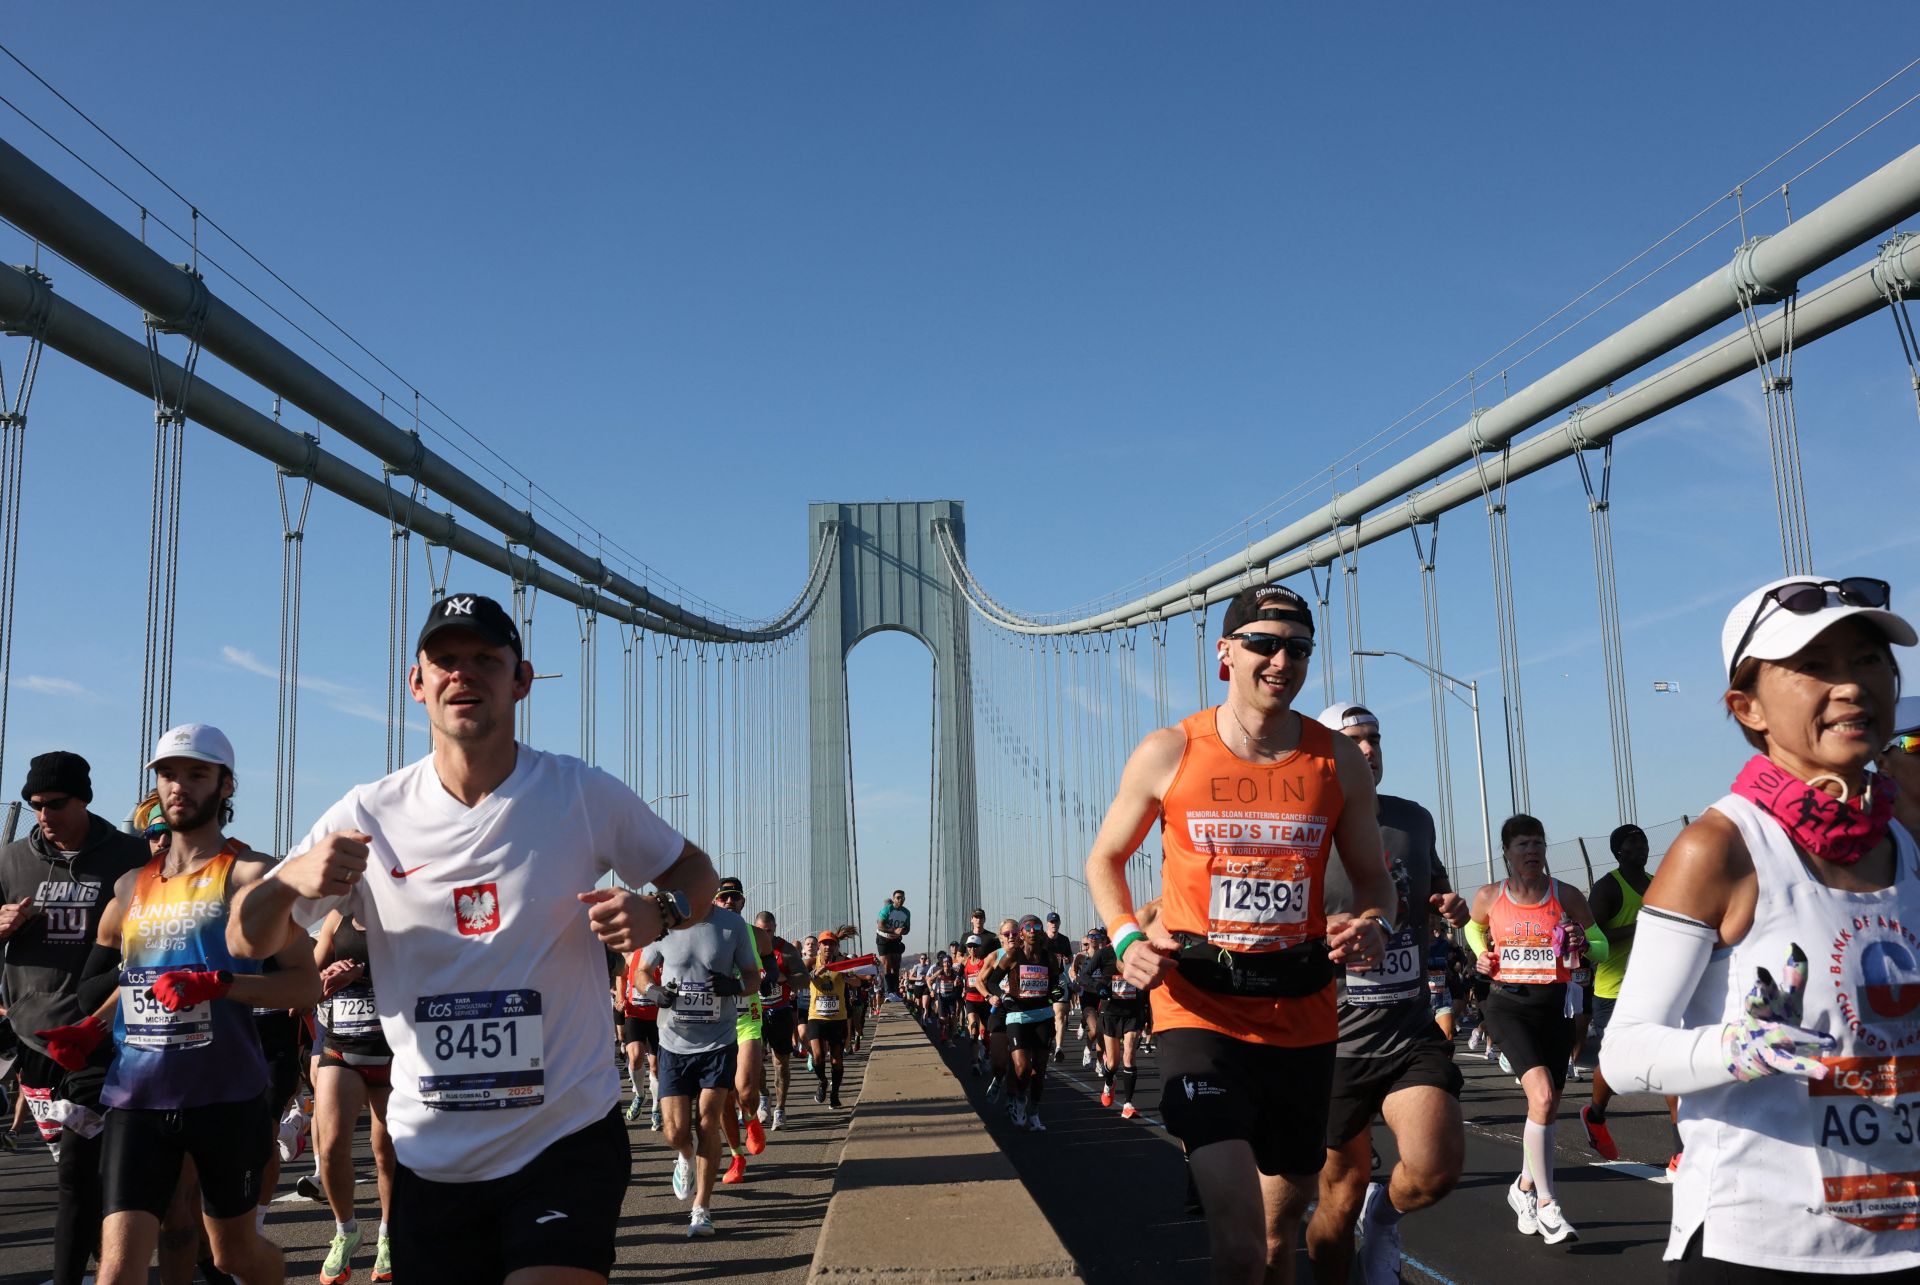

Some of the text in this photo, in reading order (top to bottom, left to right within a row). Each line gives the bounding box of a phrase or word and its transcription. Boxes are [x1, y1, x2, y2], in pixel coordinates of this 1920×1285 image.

[1186, 810, 1220, 818] MEMORIAL
[1244, 811, 1280, 819] KETTERING
[1281, 813, 1307, 821] CANCER
[1308, 815, 1329, 823] CENTER
[1194, 823, 1322, 843] FRED'S TEAM
[1222, 846, 1229, 855] A
[1230, 847, 1258, 855] WORLD
[1259, 848, 1295, 856] WITHOUT
[1227, 859, 1249, 874] tcs
[35, 881, 101, 901] GIANTS
[1220, 880, 1304, 913] 12593
[127, 900, 222, 922] RUNNERS
[138, 919, 196, 937] SHOP
[159, 936, 187, 951] 1975
[1830, 928, 1852, 975] BANK
[1852, 914, 1871, 931] OF
[1502, 949, 1554, 961] AG 3918
[1360, 950, 1412, 977] 430
[127, 971, 145, 984] tcs
[454, 1002, 492, 1011] CONSULTANCY
[684, 992, 714, 1006] 5715
[340, 999, 376, 1016] 7225
[428, 1001, 452, 1018] tcs
[454, 1009, 479, 1017] SERVICES
[502, 1005, 525, 1014] TATA
[145, 1016, 181, 1024] MICHAEL
[1836, 992, 1887, 1052] CHICAGO
[435, 1020, 517, 1062] 8451
[1834, 1065, 1873, 1090] tcs
[483, 1090, 491, 1099] D
[508, 1087, 533, 1096] 2025
[1821, 1103, 1880, 1148] AG
[1827, 1204, 1855, 1214] WAVE
[1856, 1202, 1863, 1215] 1
[1868, 1202, 1900, 1212] ORANGE
